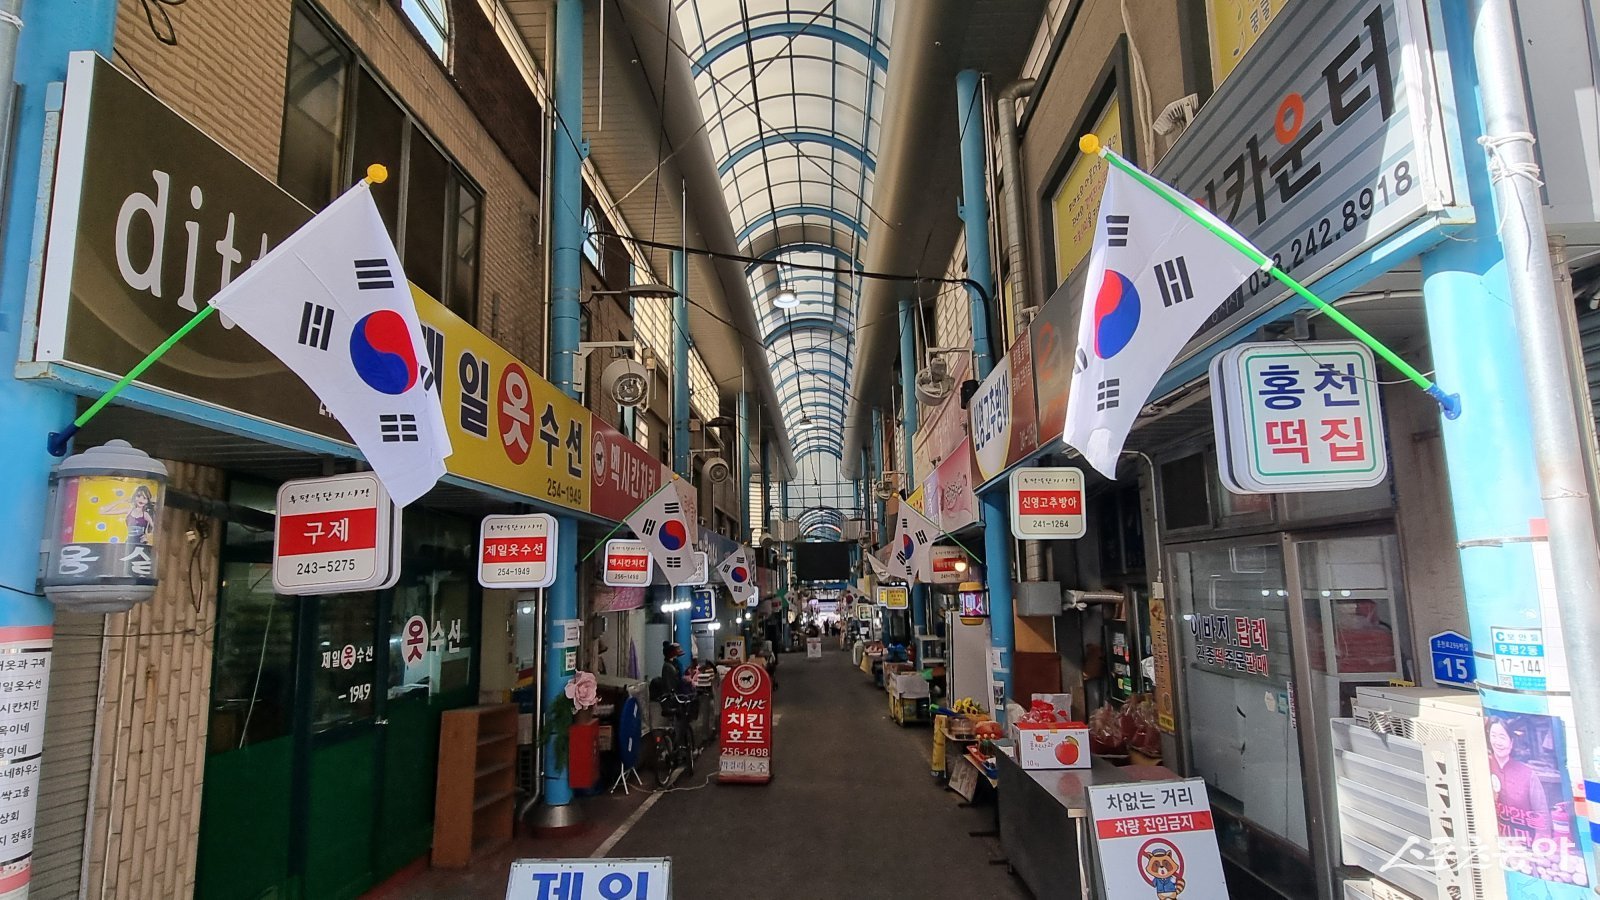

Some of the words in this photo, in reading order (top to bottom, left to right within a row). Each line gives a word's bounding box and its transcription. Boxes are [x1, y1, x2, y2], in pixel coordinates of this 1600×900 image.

[115, 169, 269, 330] dit
[1258, 363, 1360, 410] 홍천
[1265, 417, 1366, 464] 떡집
[546, 478, 582, 506] 254-1949
[1022, 496, 1077, 509] 신영고추방아
[303, 517, 349, 546] 구제
[1032, 520, 1069, 528] 241-1264
[485, 542, 544, 557] 제일옷수선
[296, 559, 355, 576] 243-5275
[497, 567, 531, 576] 254-1949
[30, 657, 46, 668] 구제
[321, 644, 374, 670] 제일옷수선
[1442, 657, 1469, 680] 15
[1501, 658, 1541, 674] 17-144
[727, 713, 764, 729] 치킨
[726, 729, 765, 744] 호프
[721, 747, 769, 757] 256-1498
[1106, 790, 1156, 812] 차없는
[1161, 787, 1194, 808] 거리
[1115, 819, 1140, 835] 차량
[1143, 814, 1195, 833] 진입금지
